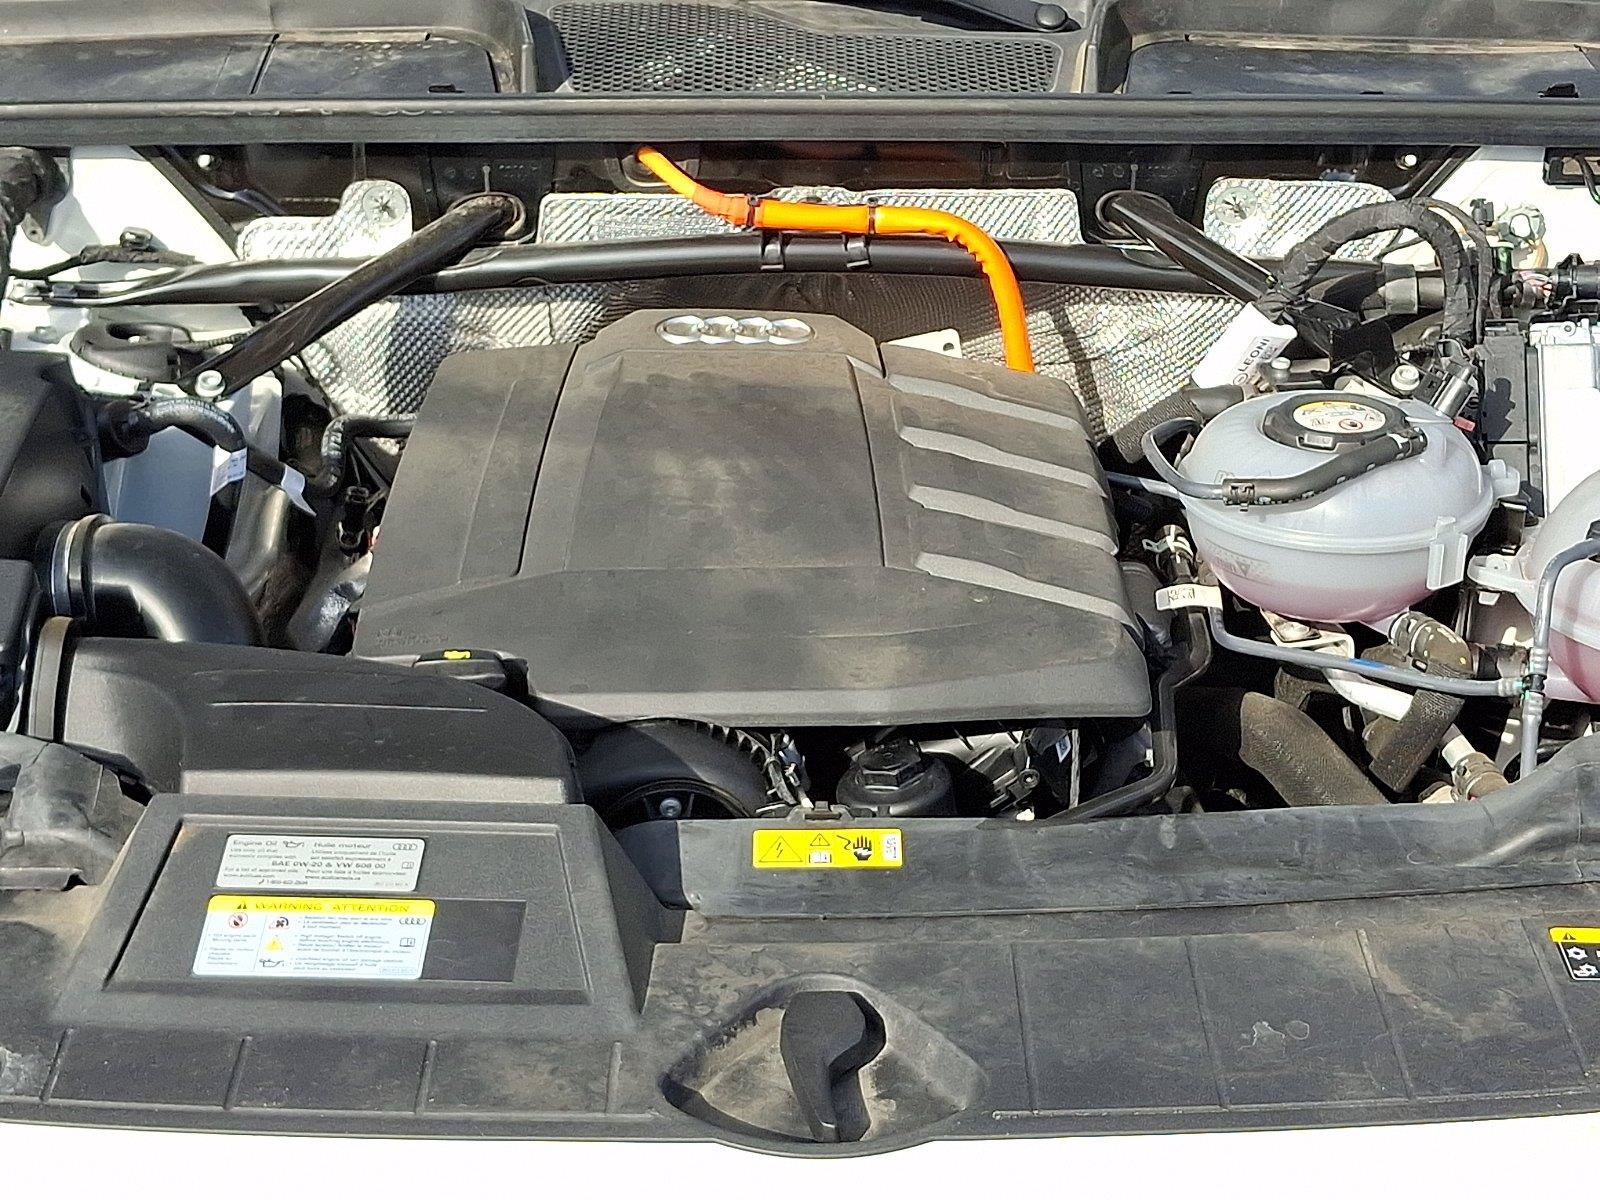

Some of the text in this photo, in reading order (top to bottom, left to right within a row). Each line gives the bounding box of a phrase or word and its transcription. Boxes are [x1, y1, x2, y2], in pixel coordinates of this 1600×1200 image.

[1237, 338, 1270, 372] LEONI
[233, 839, 263, 847] Engine
[255, 902, 411, 913] WARNING ATTENTION
